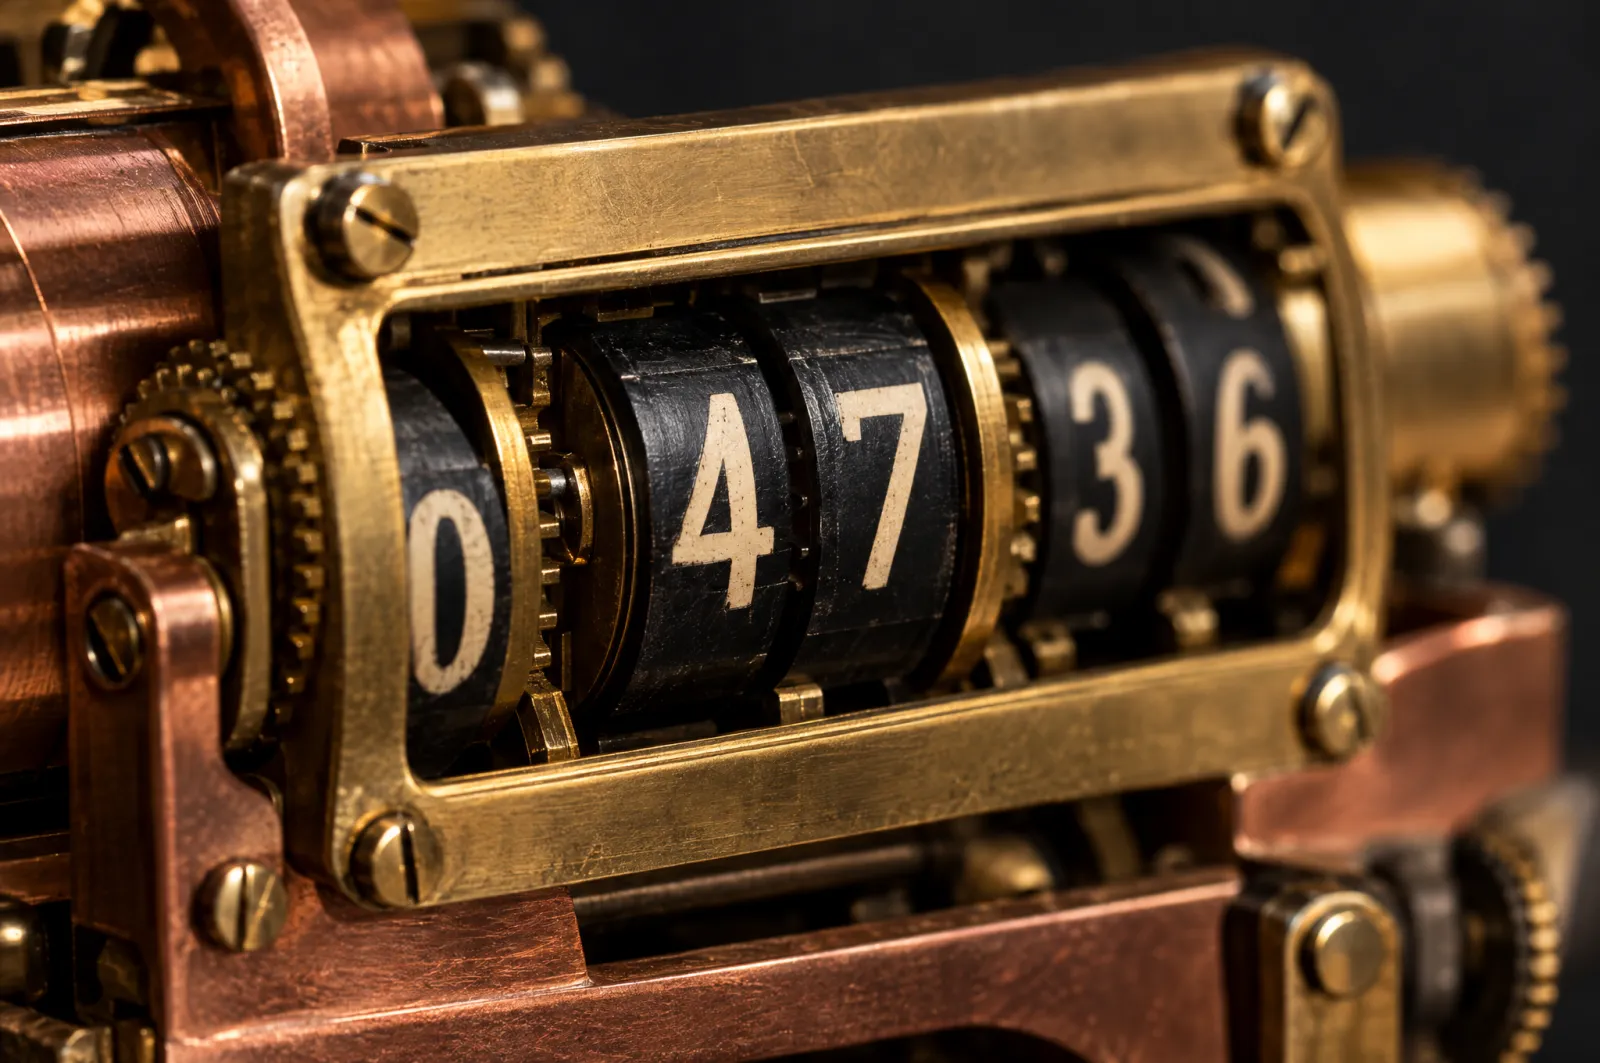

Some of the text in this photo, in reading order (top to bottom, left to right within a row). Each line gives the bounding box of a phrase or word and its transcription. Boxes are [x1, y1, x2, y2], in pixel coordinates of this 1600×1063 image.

[409, 348, 1287, 694] 0 4 7 3 6
